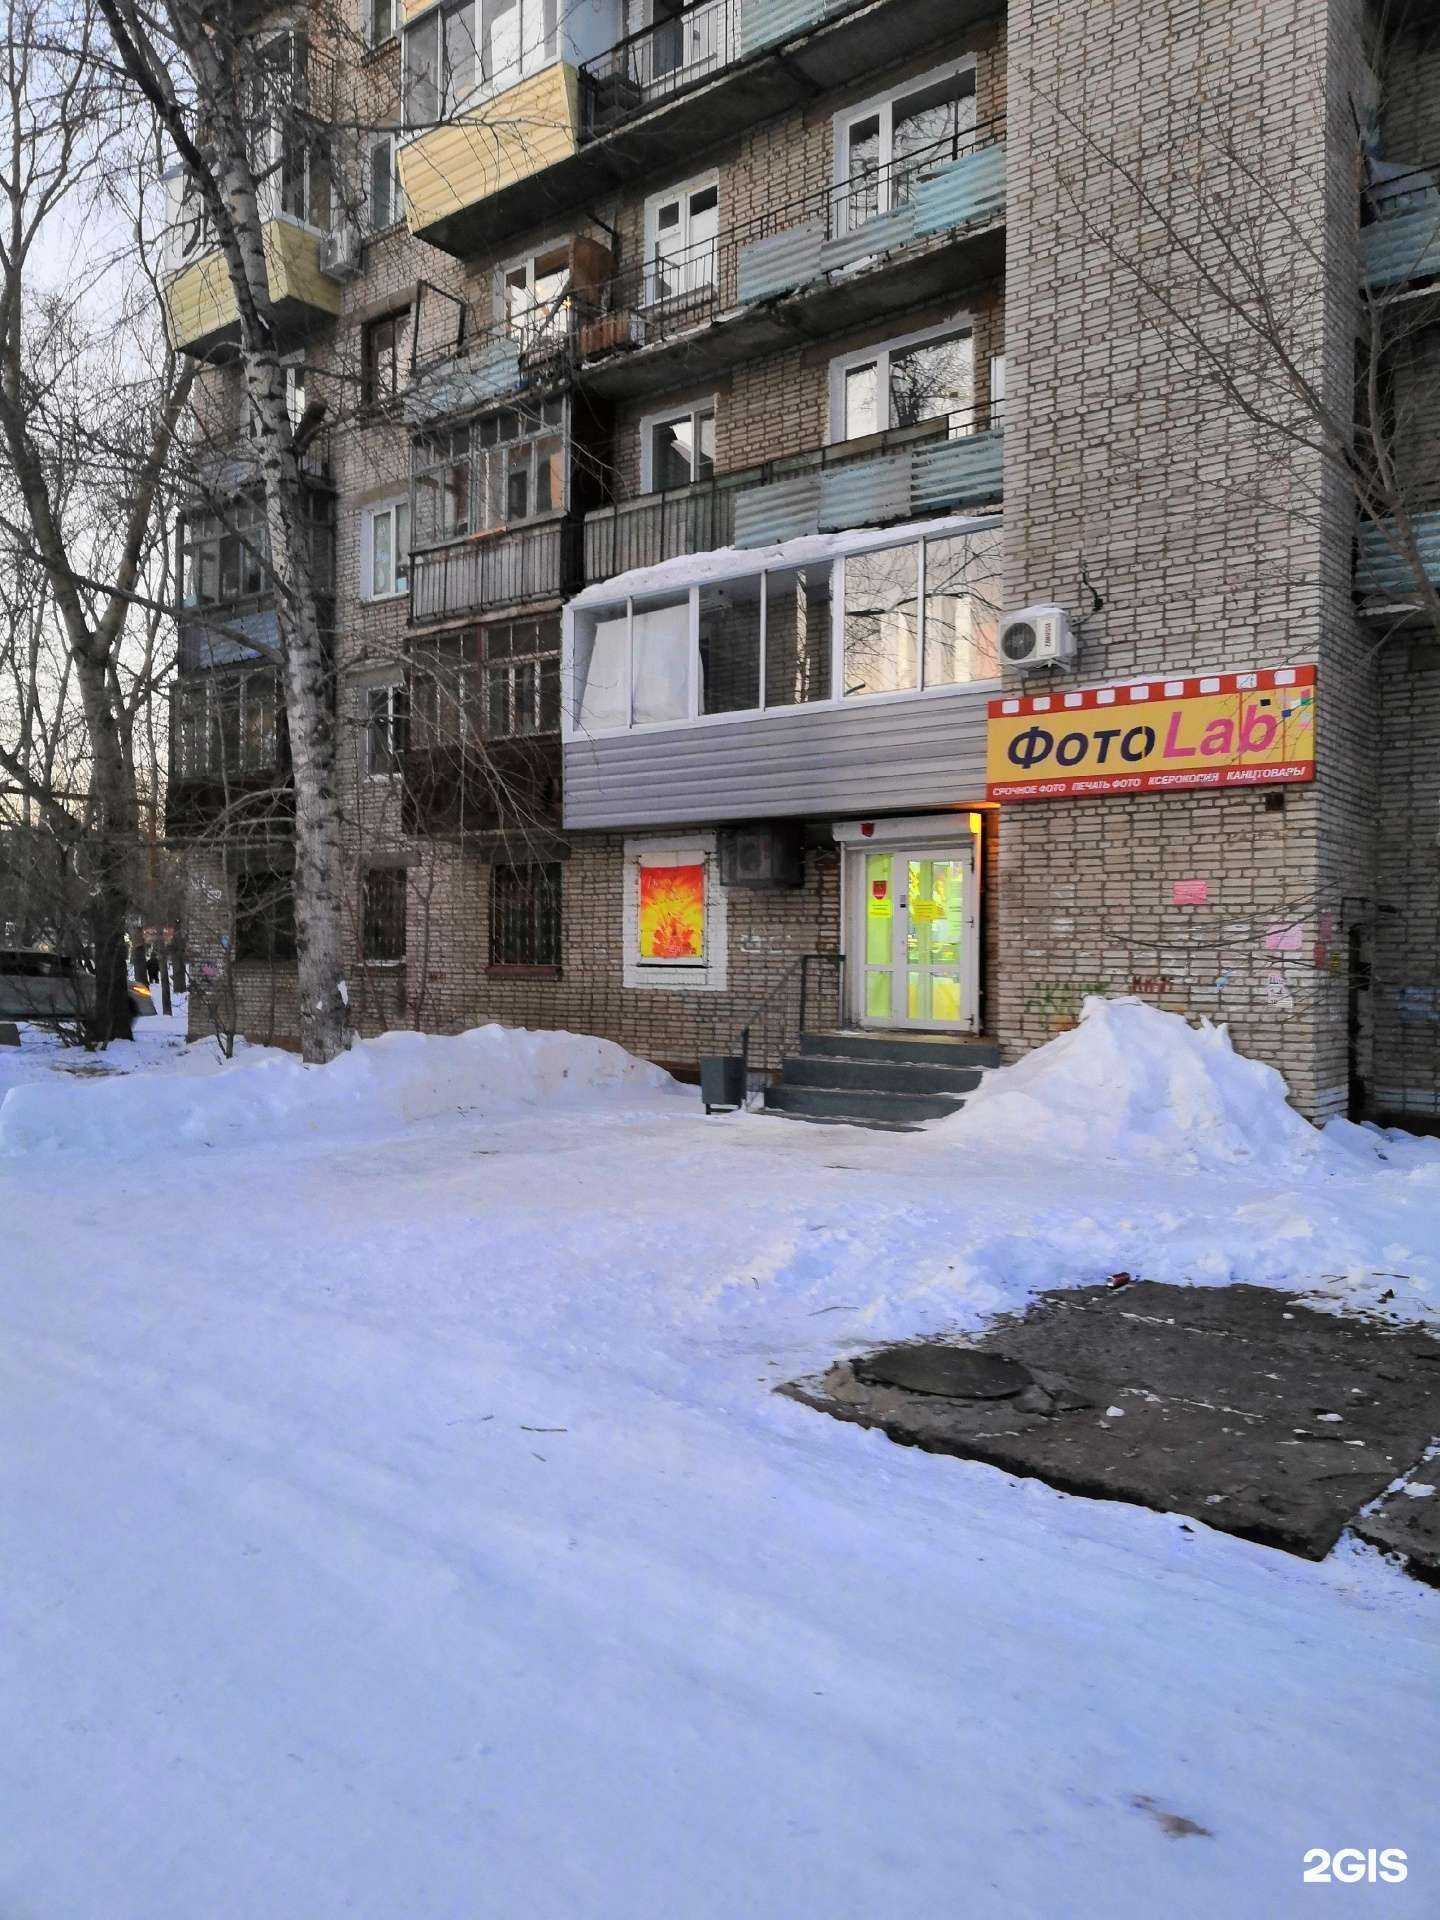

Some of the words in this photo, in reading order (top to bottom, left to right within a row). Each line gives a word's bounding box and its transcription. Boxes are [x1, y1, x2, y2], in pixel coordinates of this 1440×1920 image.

[992, 786, 1038, 796] СРОЧНОЕ
[1038, 783, 1067, 793] ФОТО
[1071, 780, 1111, 791] ПЕЧАТЬ
[1112, 778, 1142, 788] ФОТО
[1148, 772, 1220, 785] КСЕРОКОПИЯ
[1226, 766, 1306, 781] КАНЦТОВАРЫ
